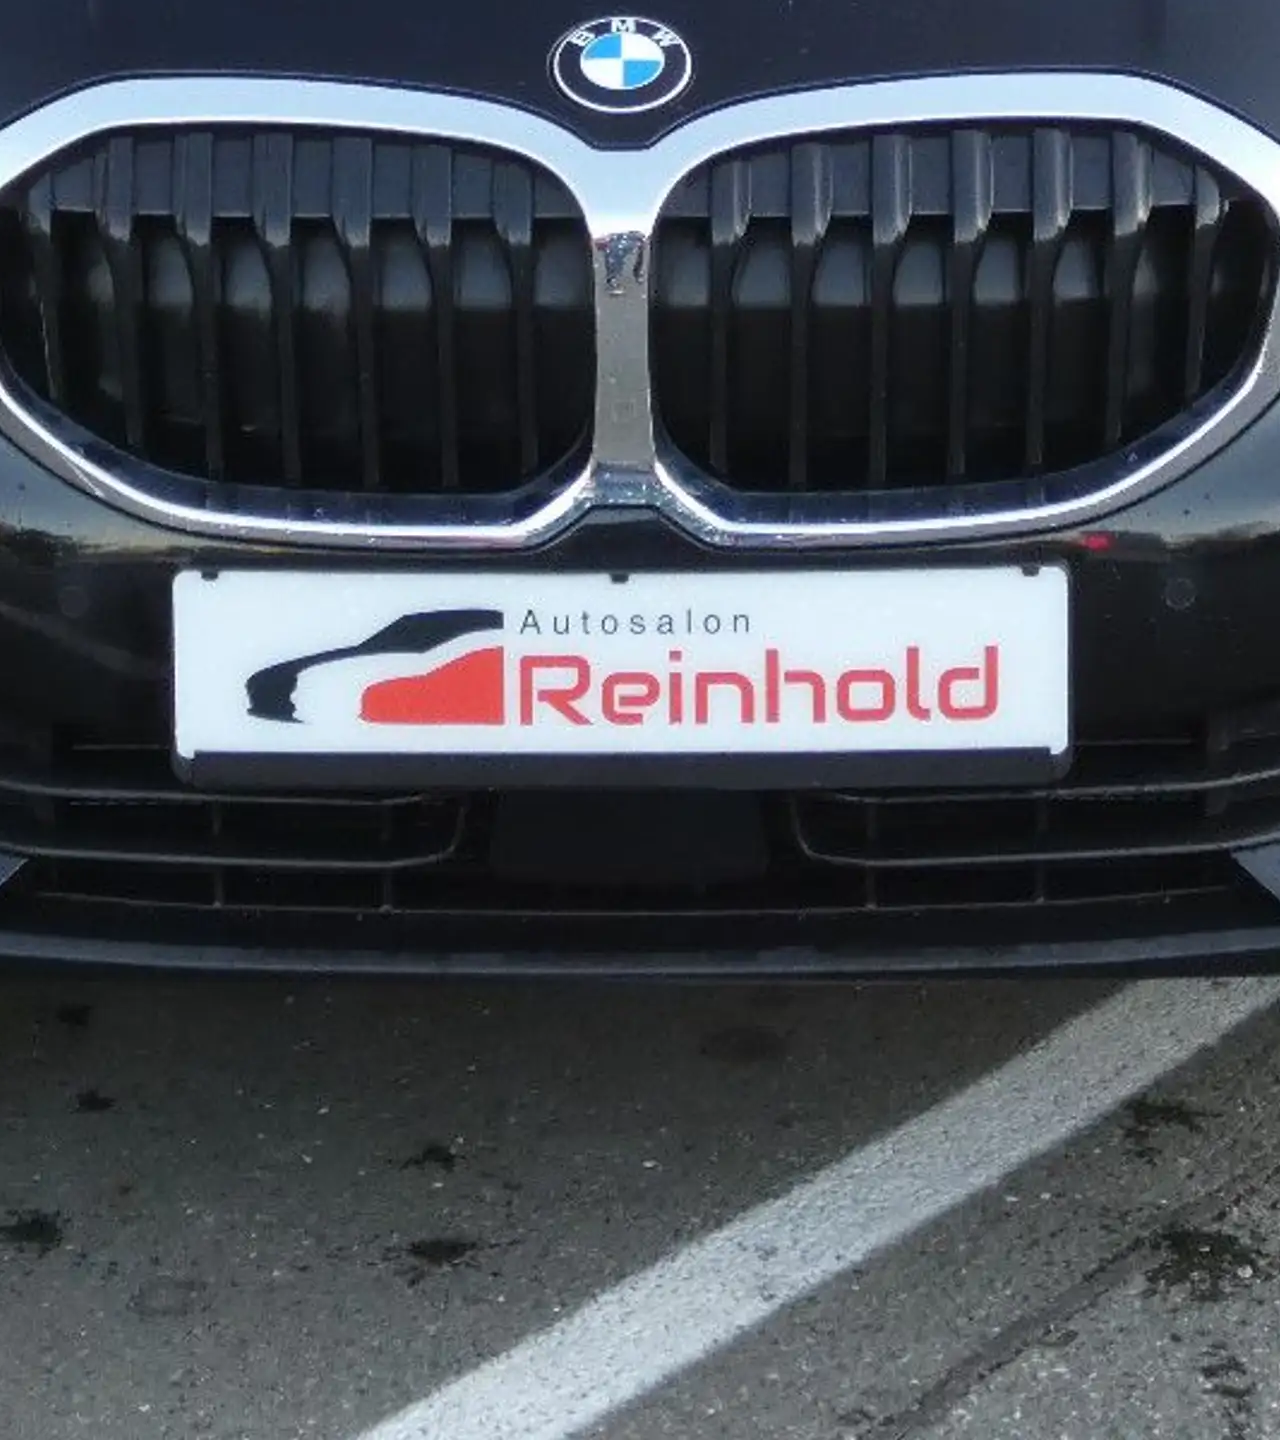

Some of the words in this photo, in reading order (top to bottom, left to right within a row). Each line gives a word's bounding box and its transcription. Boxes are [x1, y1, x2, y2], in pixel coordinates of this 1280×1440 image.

[569, 16, 681, 47] BMW
[521, 608, 753, 636] Autosalon
[521, 644, 1000, 727] Reinhold
